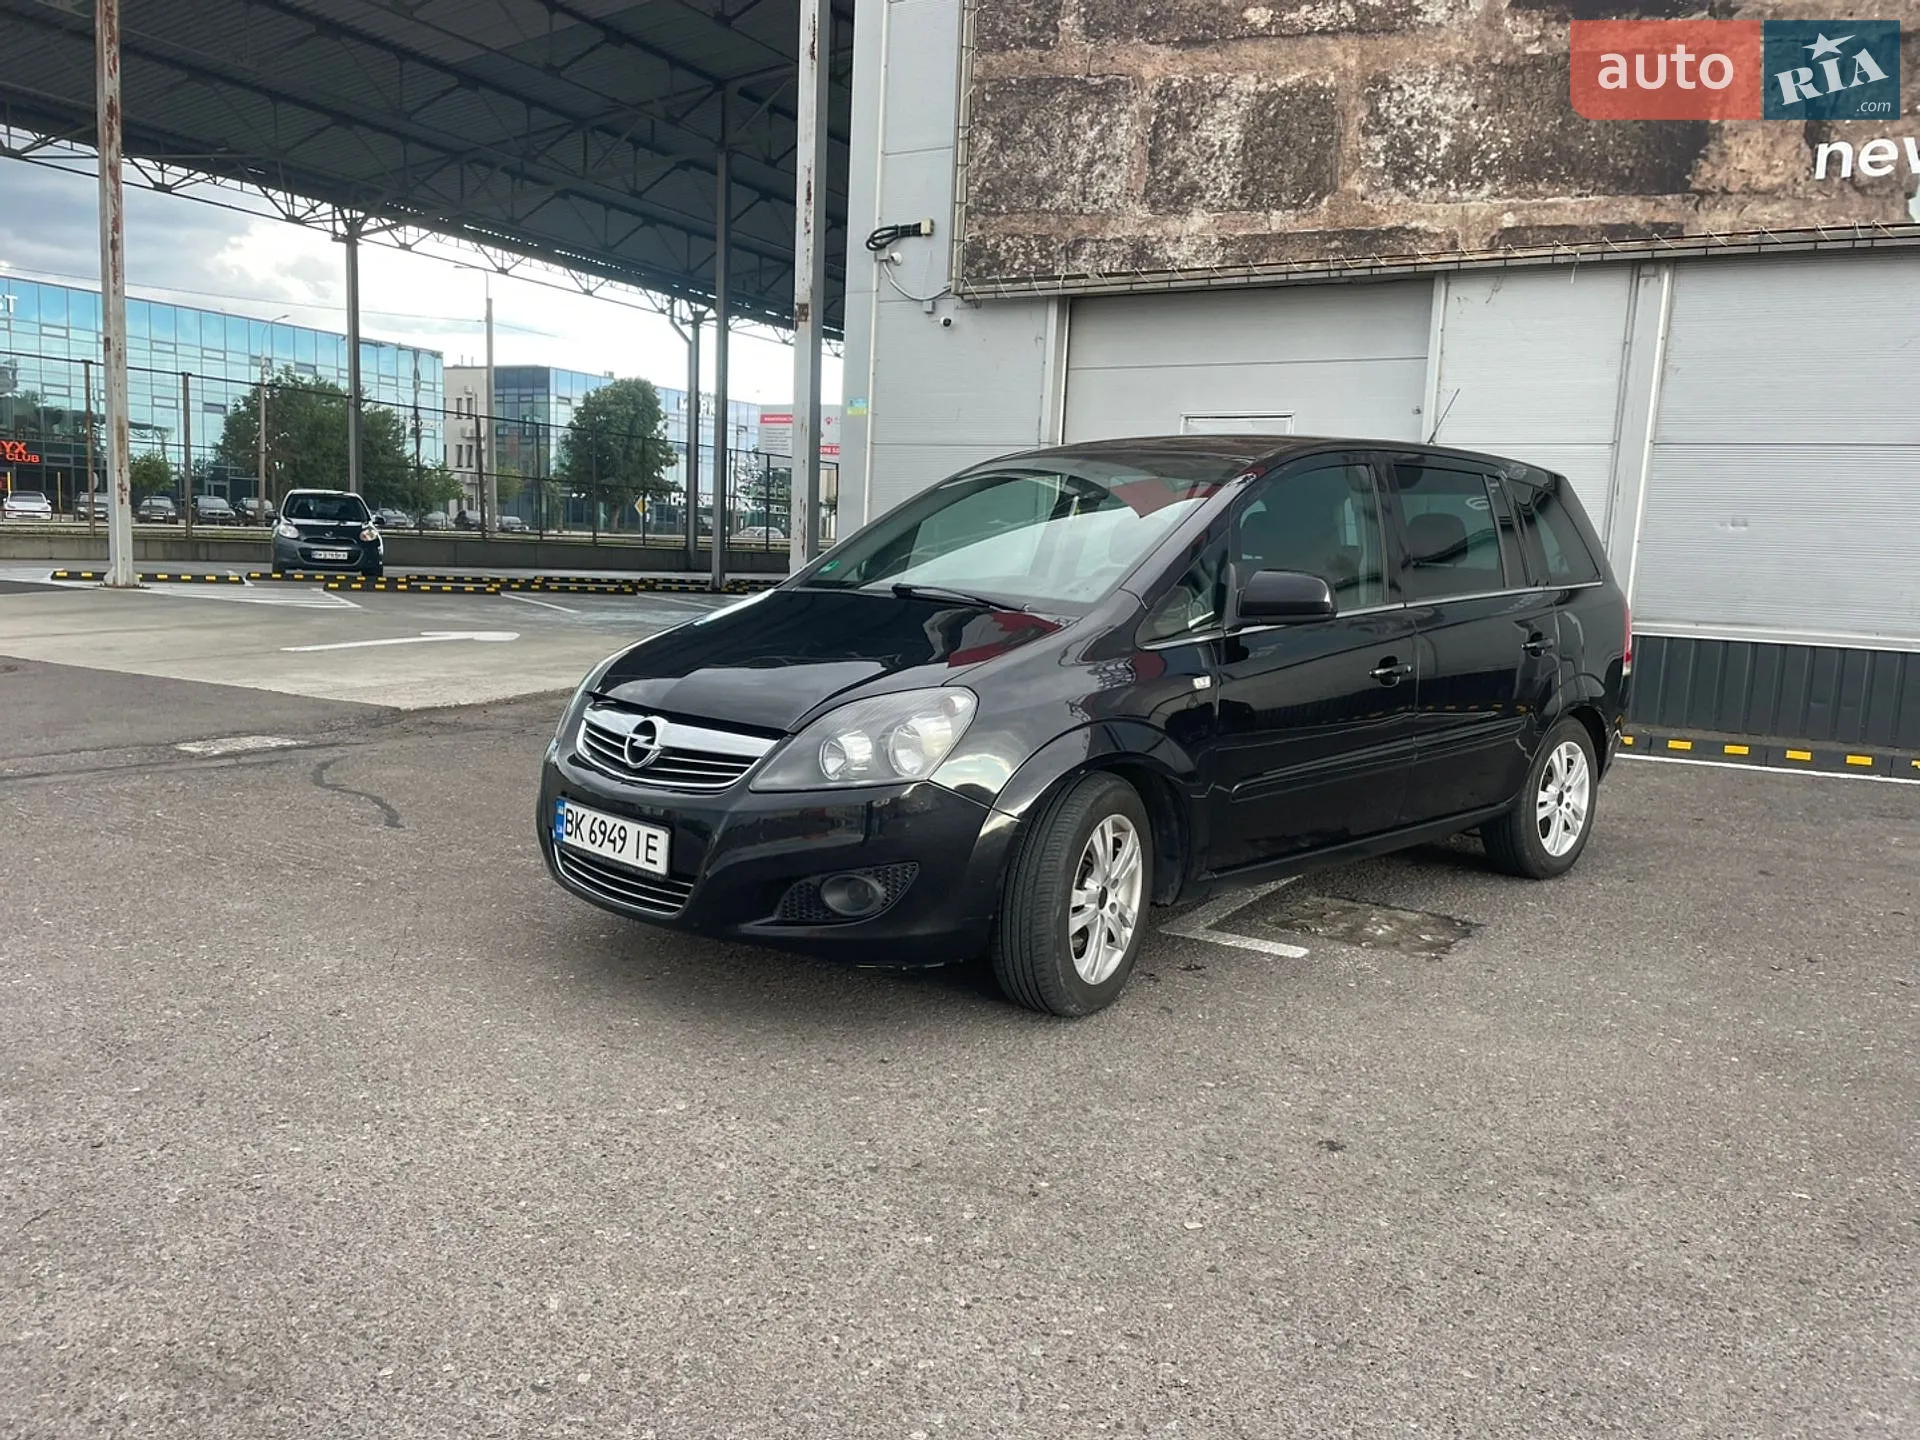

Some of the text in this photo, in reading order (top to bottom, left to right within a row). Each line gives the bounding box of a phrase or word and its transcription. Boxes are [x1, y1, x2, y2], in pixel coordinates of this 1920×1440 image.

[6, 453, 40, 463] CLUB
[565, 808, 658, 865] BK 6949 IE
